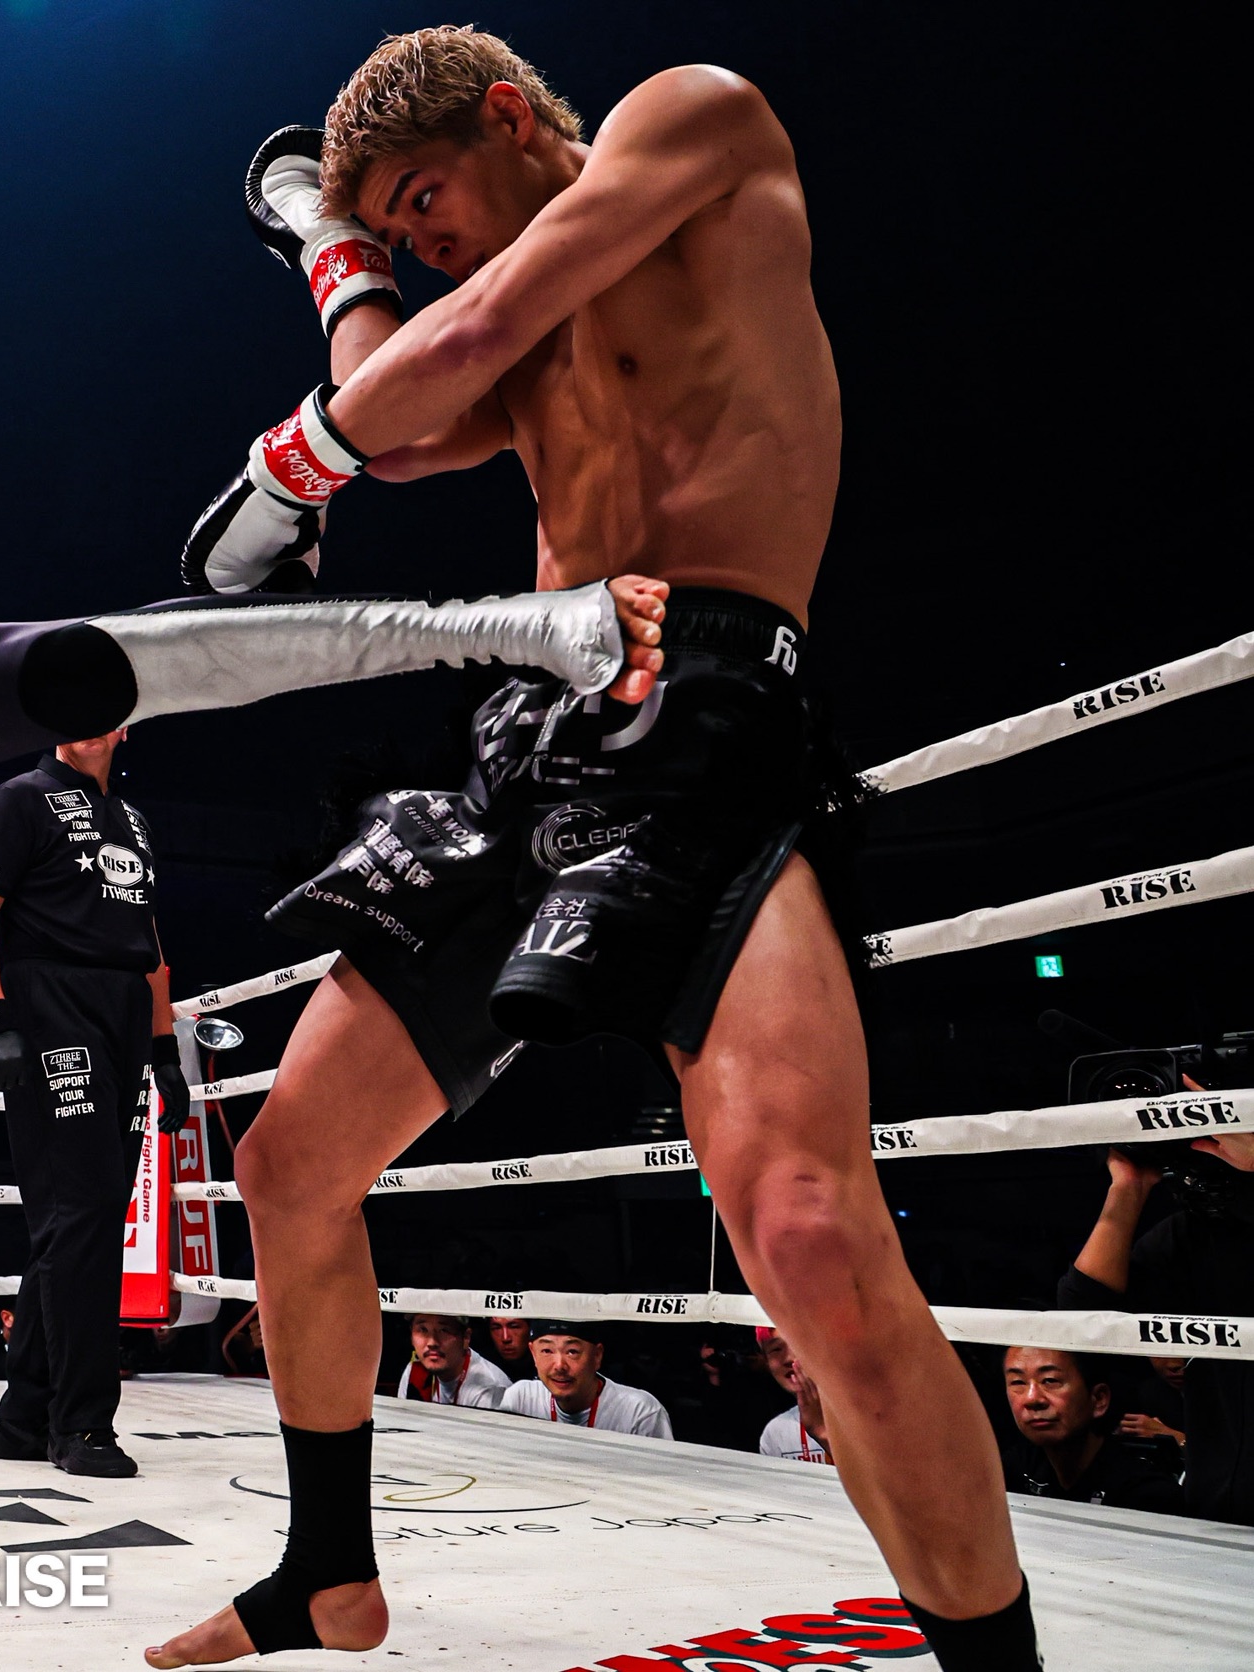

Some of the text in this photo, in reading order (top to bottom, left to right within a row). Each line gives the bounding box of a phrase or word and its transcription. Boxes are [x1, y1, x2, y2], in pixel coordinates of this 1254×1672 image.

[1073, 671, 1166, 720] RISE
[58, 810, 93, 822] SUPPORT
[72, 820, 92, 830] YOUR
[68, 832, 102, 842] FIGHTER
[101, 855, 141, 873] RISE
[1100, 870, 1196, 909] RISE
[304, 882, 424, 952] Dream support
[536, 898, 587, 919] 会社
[49, 1075, 90, 1091] SUPPORT
[59, 1089, 85, 1103] YOUR
[55, 1102, 95, 1119] FIGHTER
[1136, 1101, 1241, 1131] RISE
[871, 1129, 917, 1151] ISE
[139, 1133, 154, 1176] Fight
[645, 1147, 695, 1166] RISE
[491, 1165, 532, 1181] RISE
[142, 1178, 154, 1223] Game
[179, 1127, 209, 1272] RUF
[377, 1290, 398, 1304] SE
[484, 1294, 523, 1309] RISE
[637, 1298, 689, 1315] RISE
[1138, 1319, 1241, 1348] RISE
[274, 1510, 813, 1542] ature Japan
